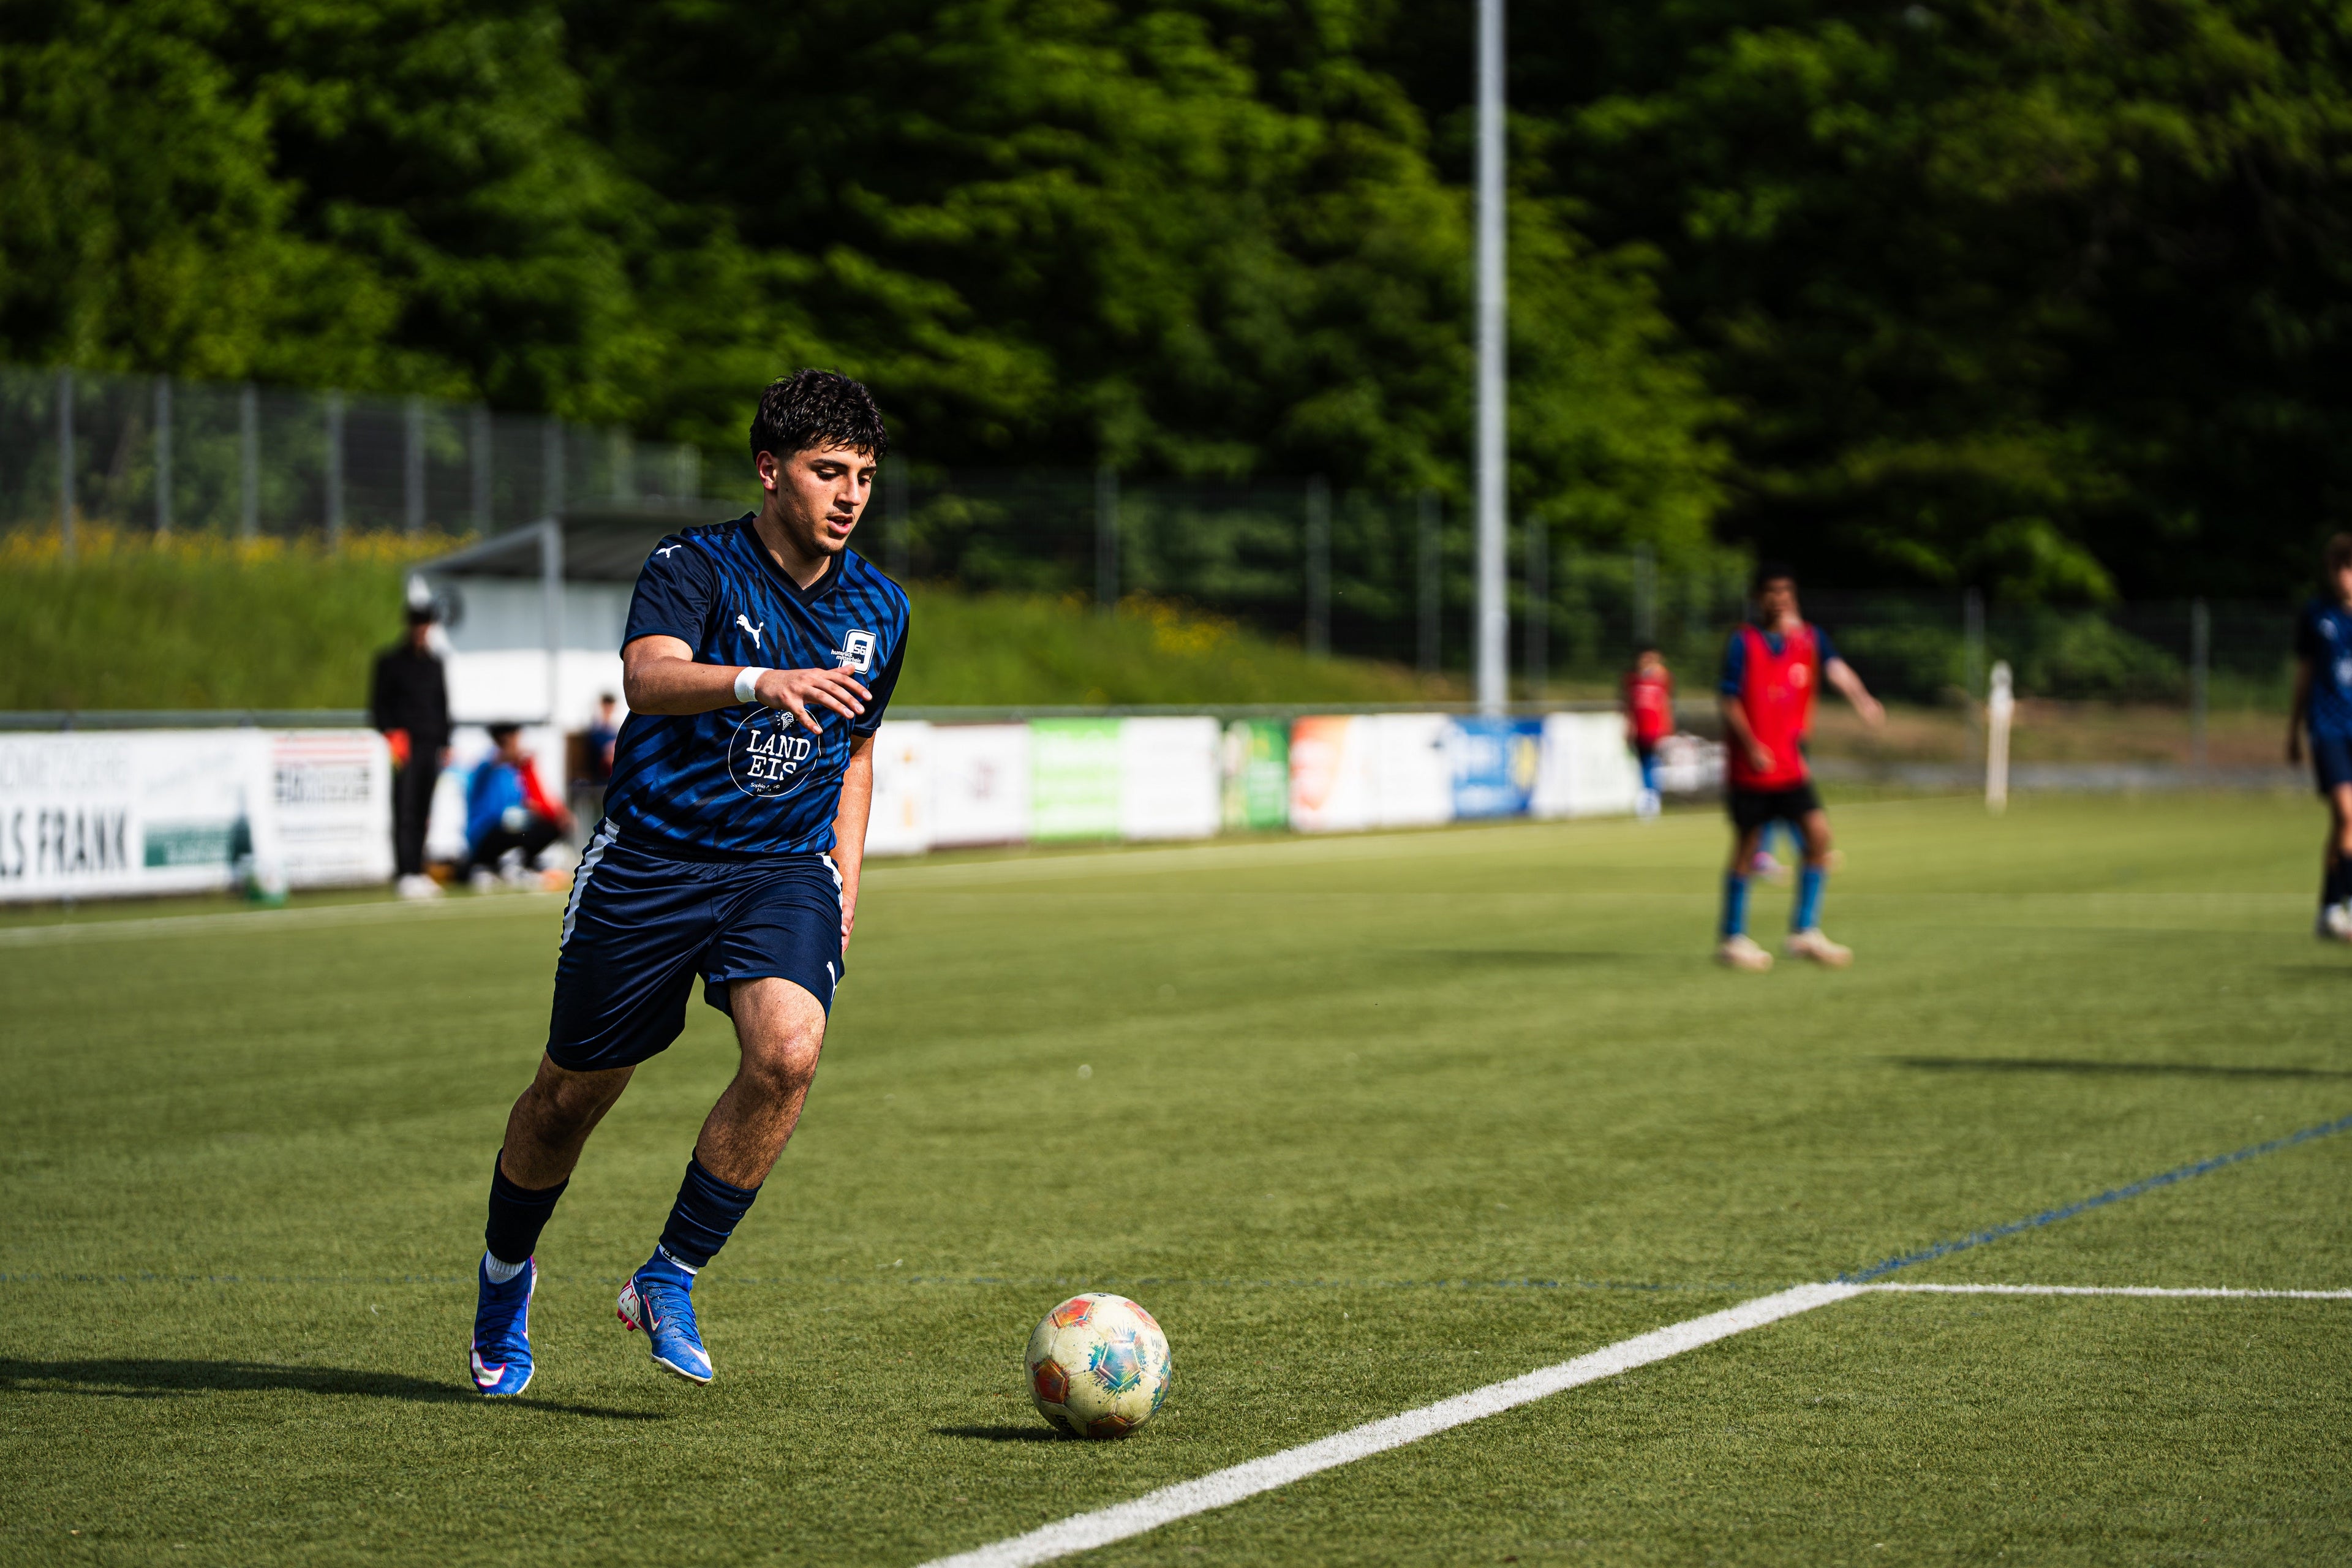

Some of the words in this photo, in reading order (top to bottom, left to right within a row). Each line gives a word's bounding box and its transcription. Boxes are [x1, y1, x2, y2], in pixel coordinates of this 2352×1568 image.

[853, 644, 867, 655] SG
[746, 729, 811, 761] LAND
[747, 755, 797, 781] EIS
[37, 805, 127, 873] FRANK
